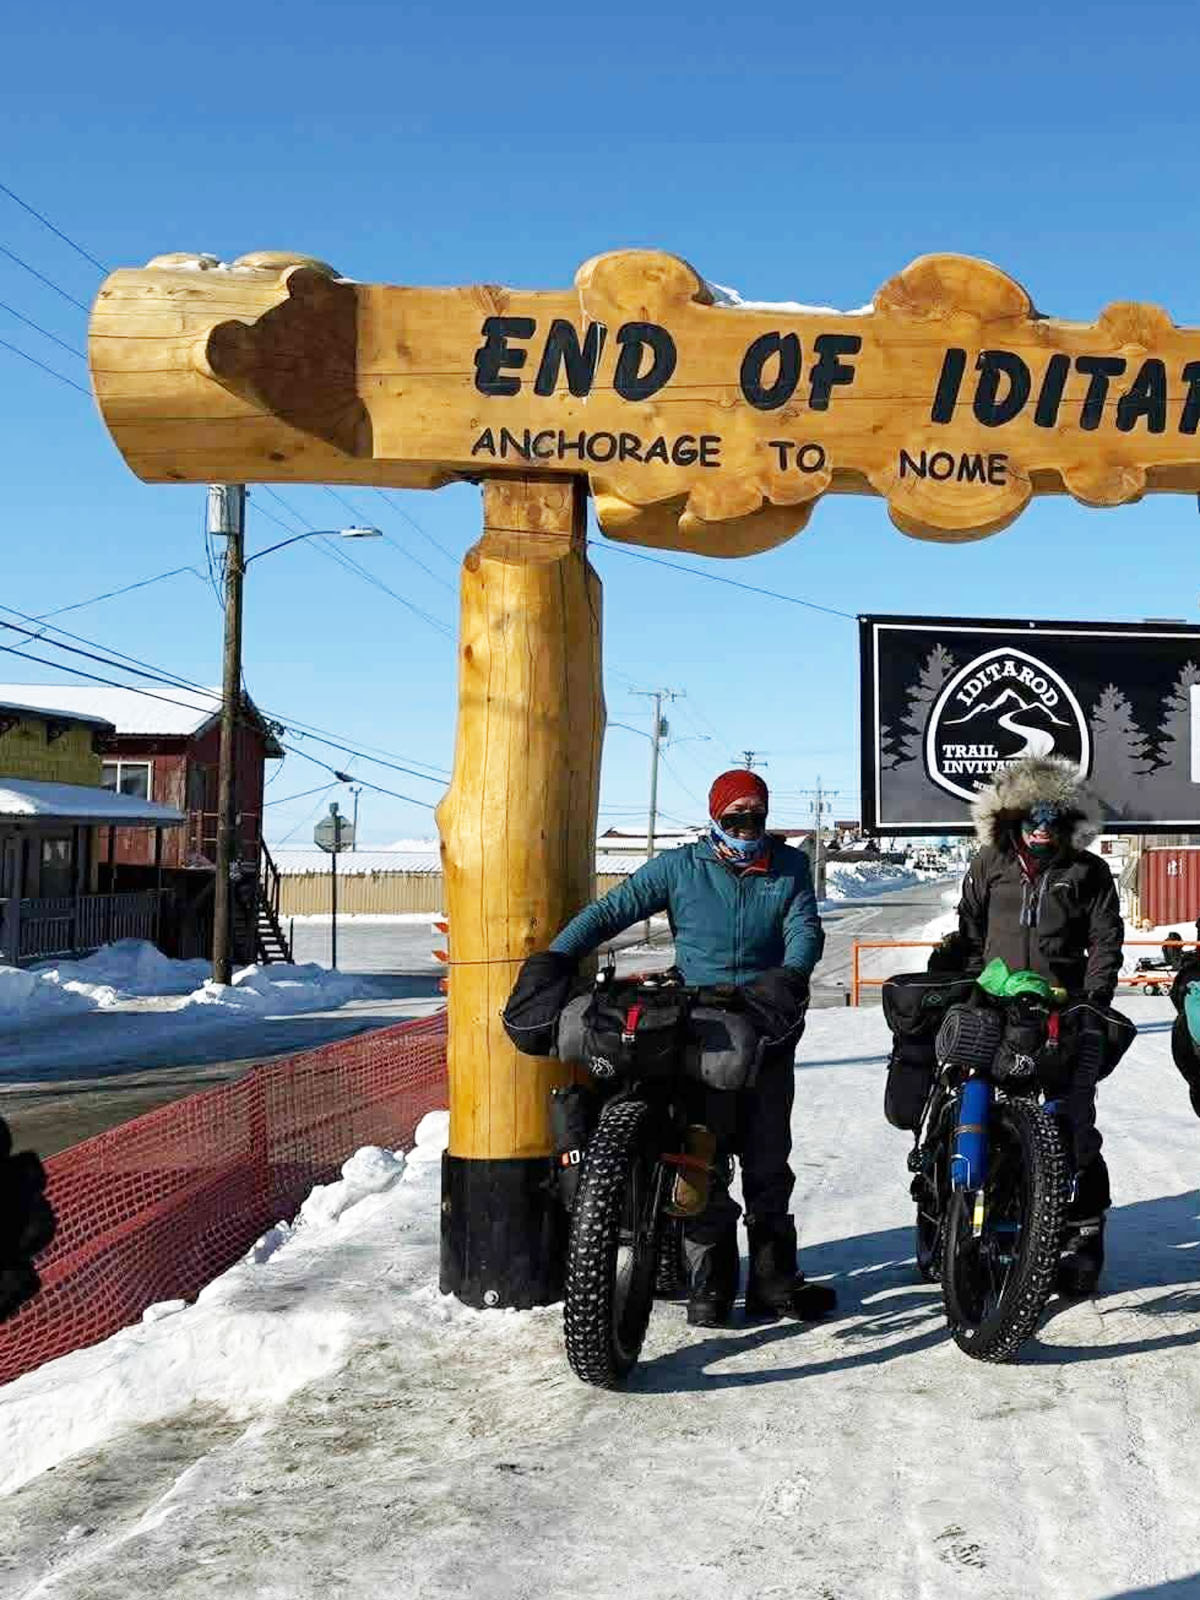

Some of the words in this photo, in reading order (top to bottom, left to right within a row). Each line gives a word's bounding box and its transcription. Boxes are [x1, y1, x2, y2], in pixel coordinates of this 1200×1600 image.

[475, 317, 676, 401] END
[741, 332, 861, 410] OF
[472, 428, 720, 467] ANCHORAGE
[769, 441, 825, 472] TO
[900, 450, 1008, 485] NOME
[956, 661, 1058, 707] IDITAROD
[942, 745, 998, 758] TRAIL
